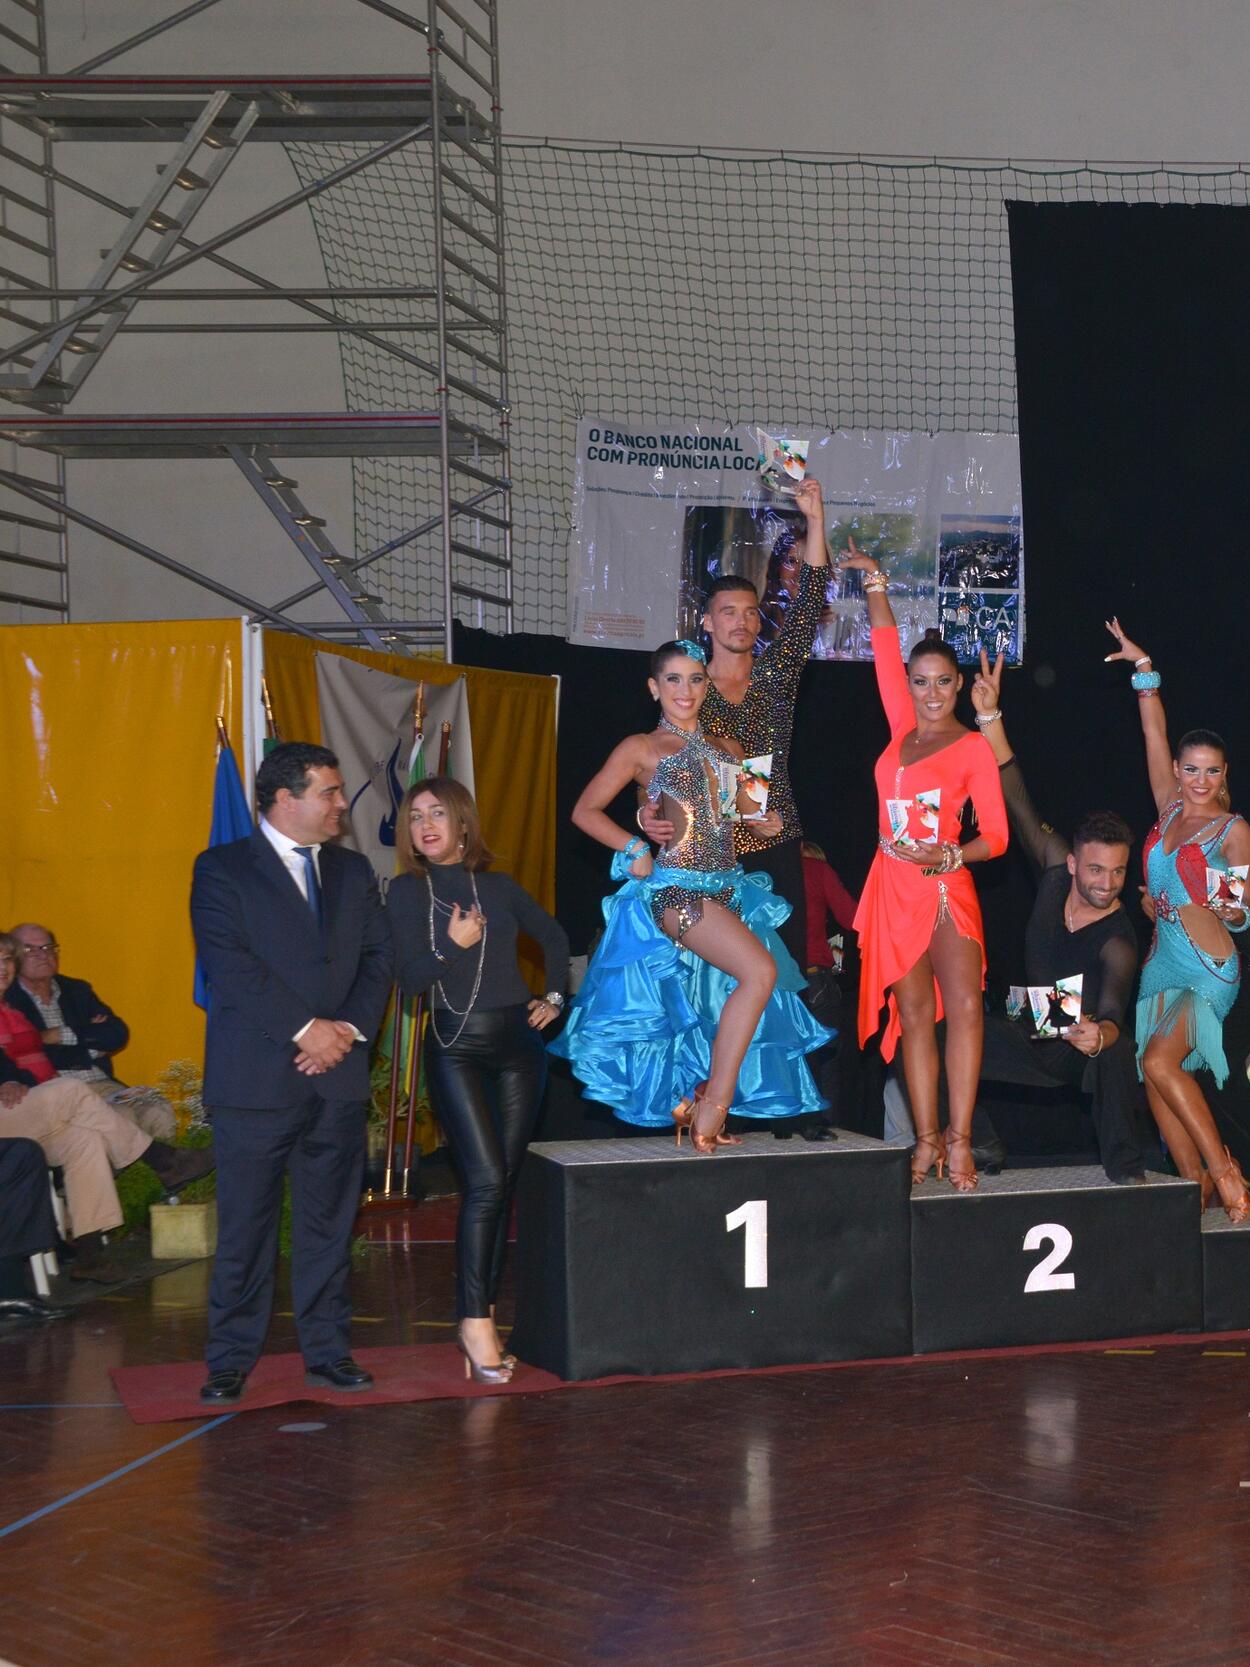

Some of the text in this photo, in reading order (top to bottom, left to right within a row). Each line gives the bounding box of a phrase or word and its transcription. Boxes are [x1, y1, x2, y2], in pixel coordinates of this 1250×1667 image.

[589, 428, 601, 443] O
[603, 430, 658, 449] BANCO
[660, 434, 744, 452] NACIONAL
[587, 446, 777, 472] COM PRONÚNCIA LOC
[976, 606, 1013, 630] CA
[724, 1200, 768, 1289] 1
[1022, 1223, 1076, 1293] 2
